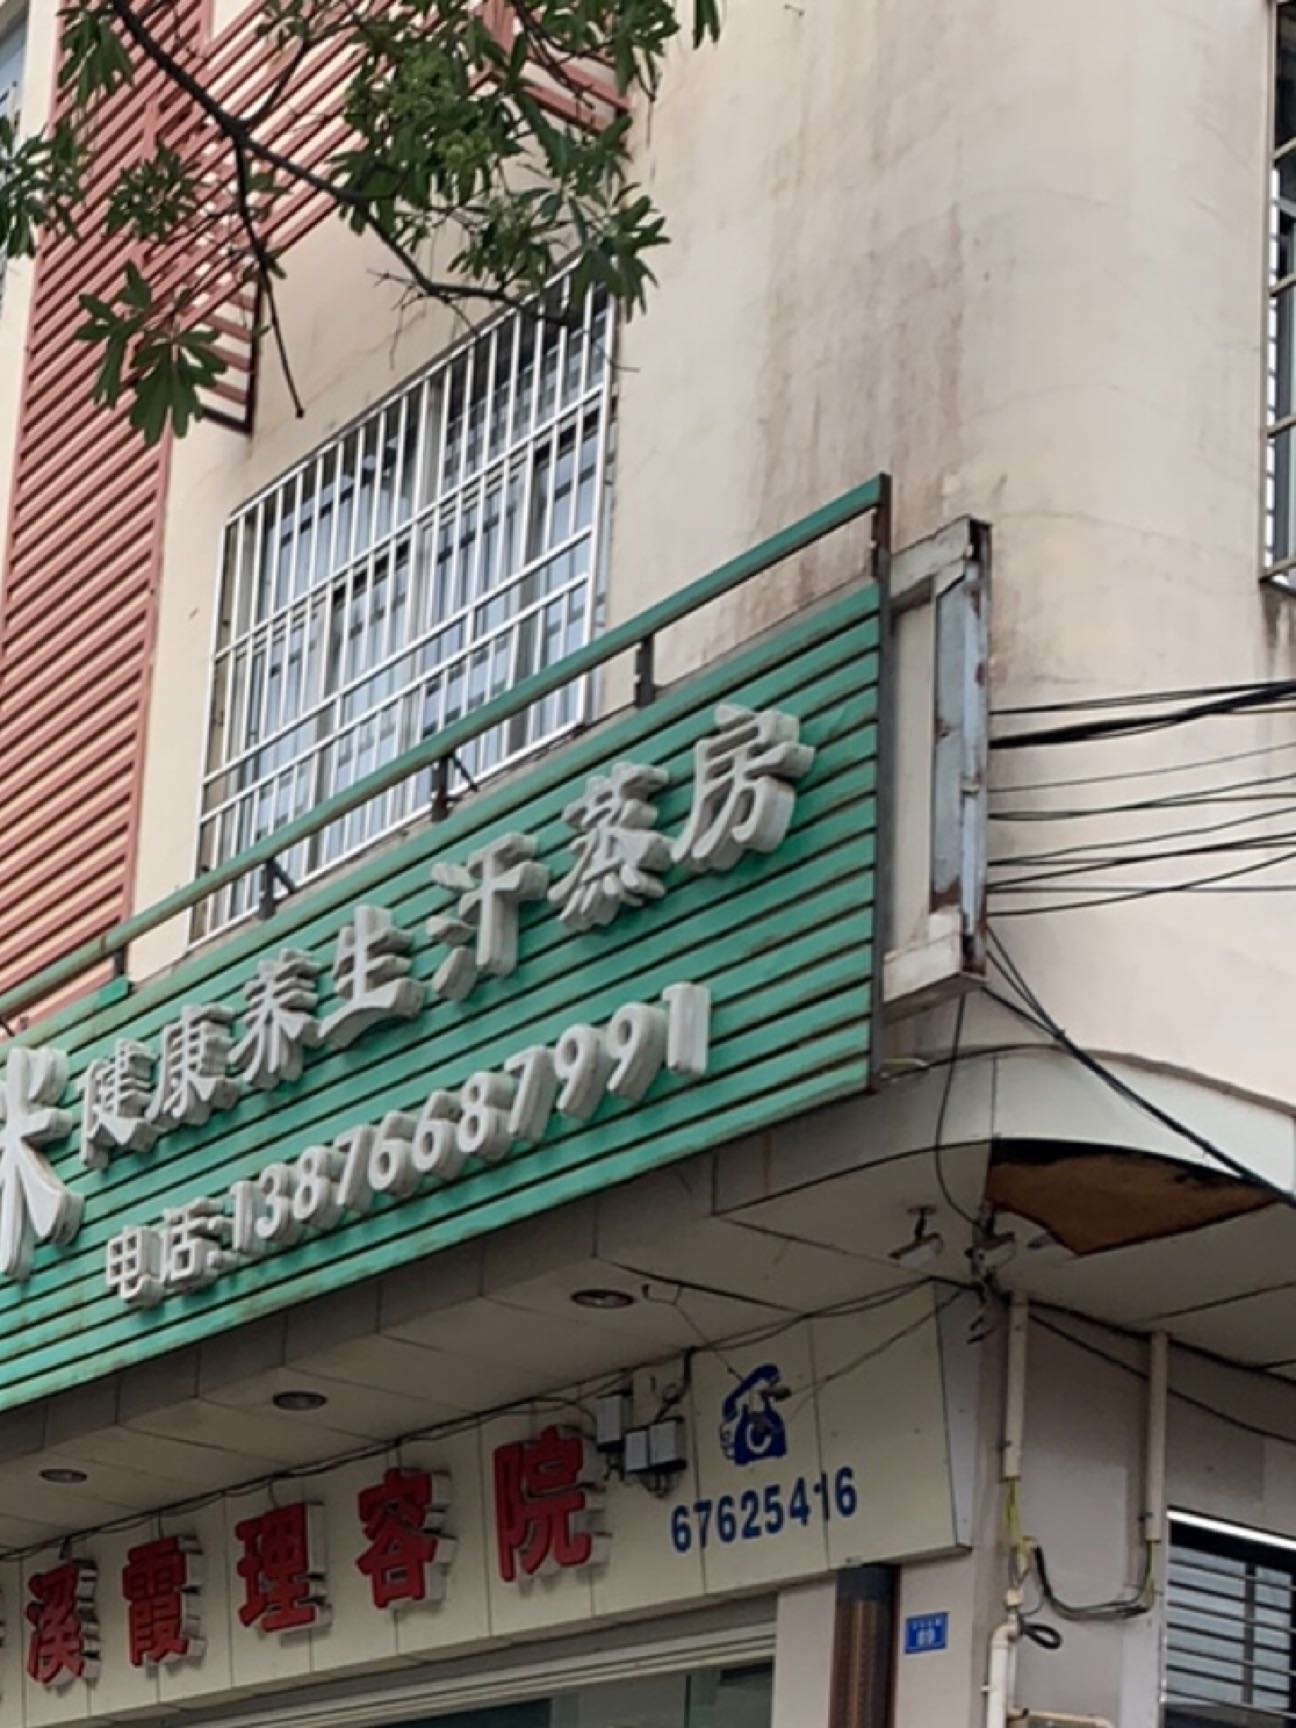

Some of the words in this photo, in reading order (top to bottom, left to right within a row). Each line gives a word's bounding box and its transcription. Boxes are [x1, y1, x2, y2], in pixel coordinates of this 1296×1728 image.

[77, 703, 814, 1169] 健康养生汗蒸房
[671, 1466, 858, 1554] 67625416
